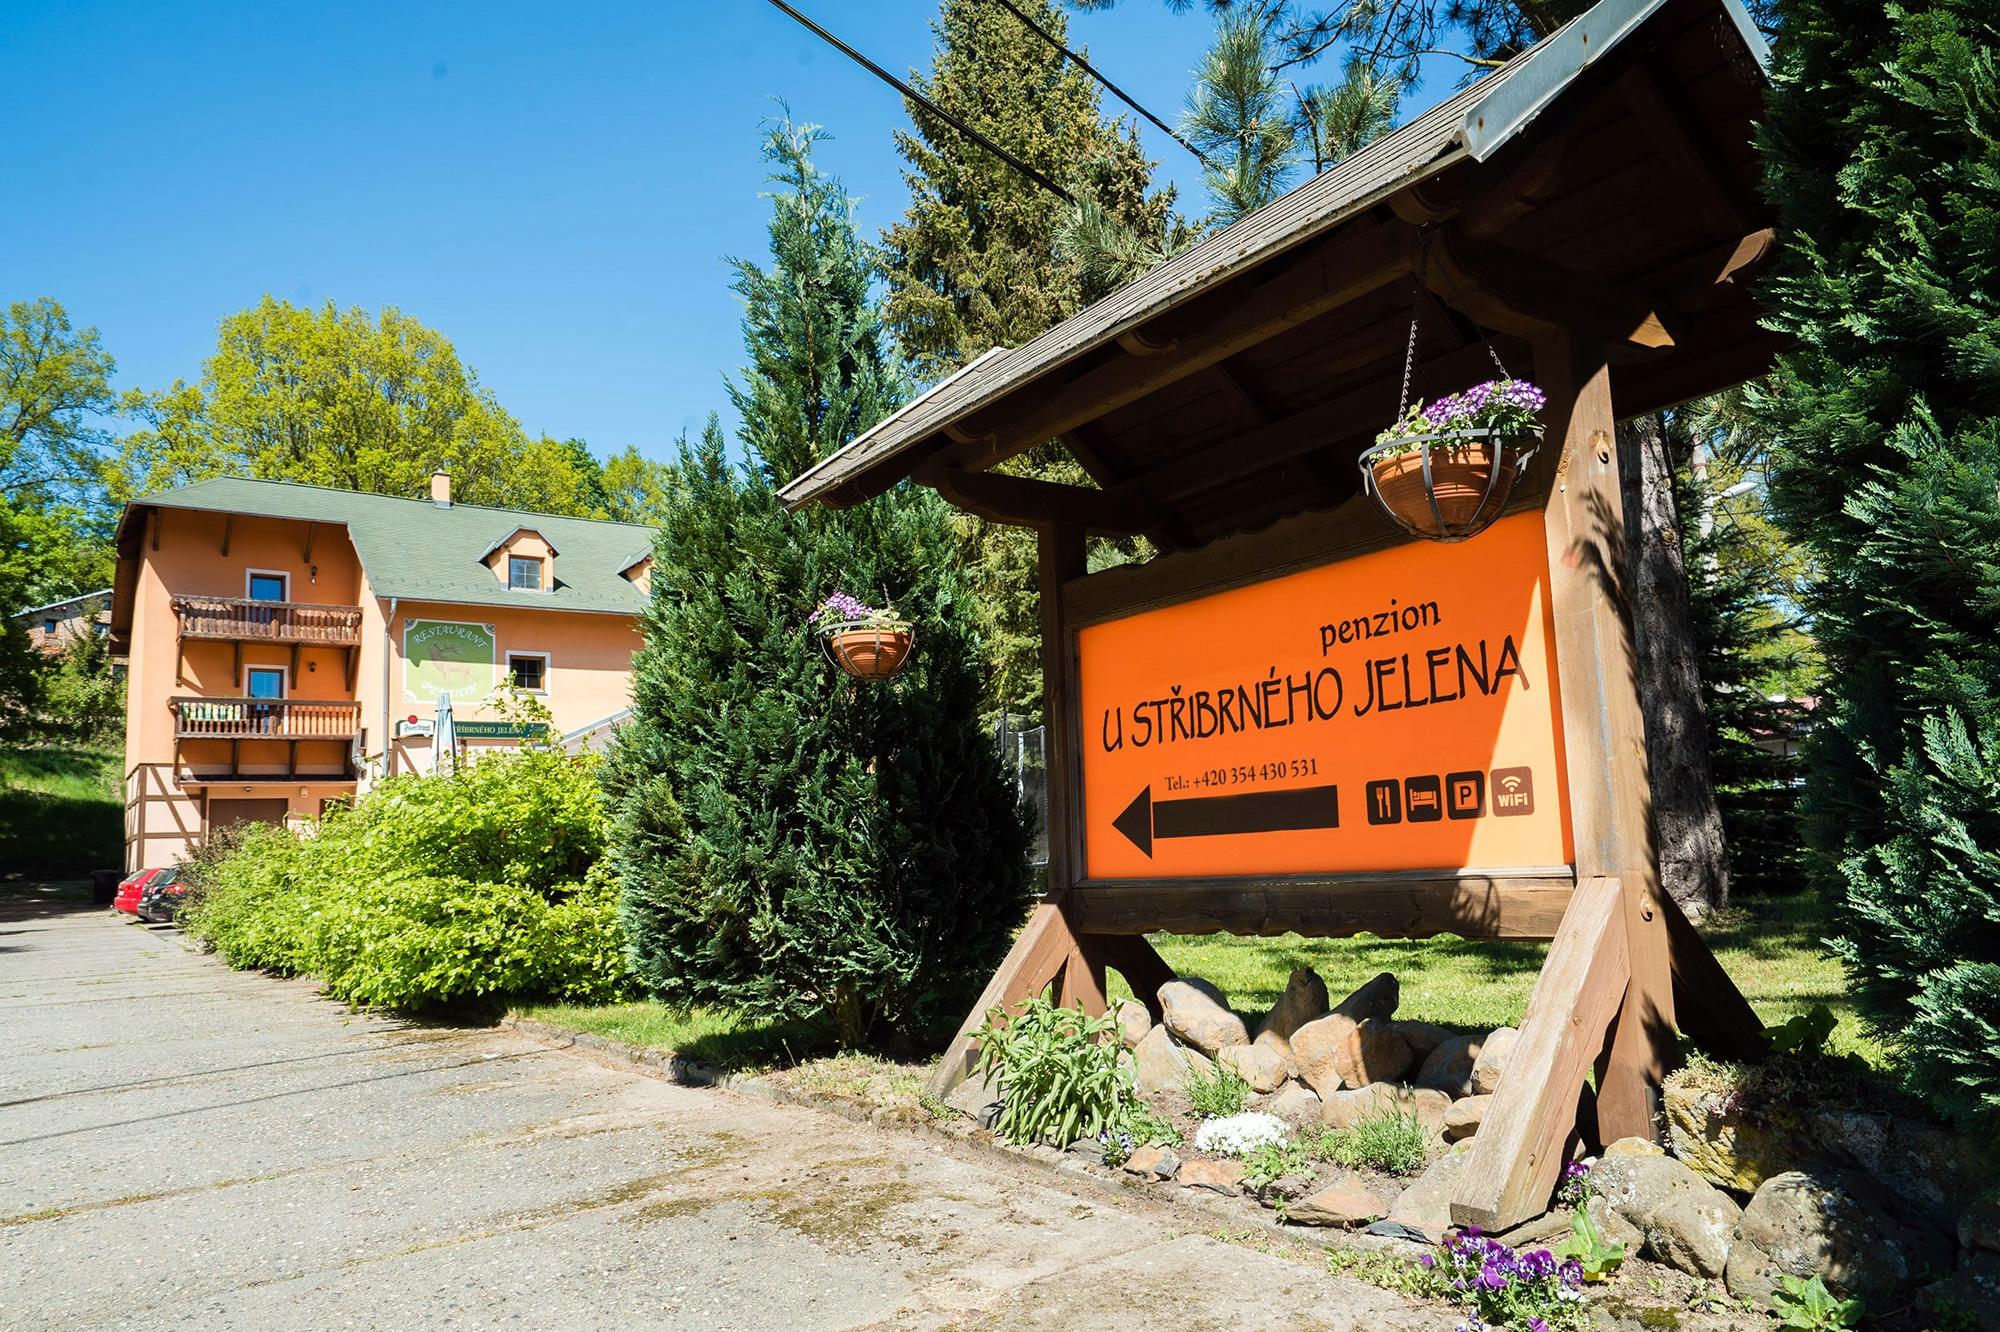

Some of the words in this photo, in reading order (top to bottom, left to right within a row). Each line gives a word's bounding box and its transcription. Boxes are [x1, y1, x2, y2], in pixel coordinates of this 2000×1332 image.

[412, 625, 489, 648] RESTAURANT
[1319, 598, 1442, 656] penzion
[1102, 706, 1123, 753] U
[1131, 666, 1343, 748] STŘIBRNÉHO
[1353, 634, 1530, 718] JELENA
[1164, 775, 1190, 791] Tel.:
[1192, 769, 1227, 787] +420
[1231, 766, 1256, 784] 354
[1259, 761, 1287, 781] 430
[1290, 758, 1318, 777] 531
[1460, 785, 1472, 805] P
[1497, 792, 1528, 808] WiFi
